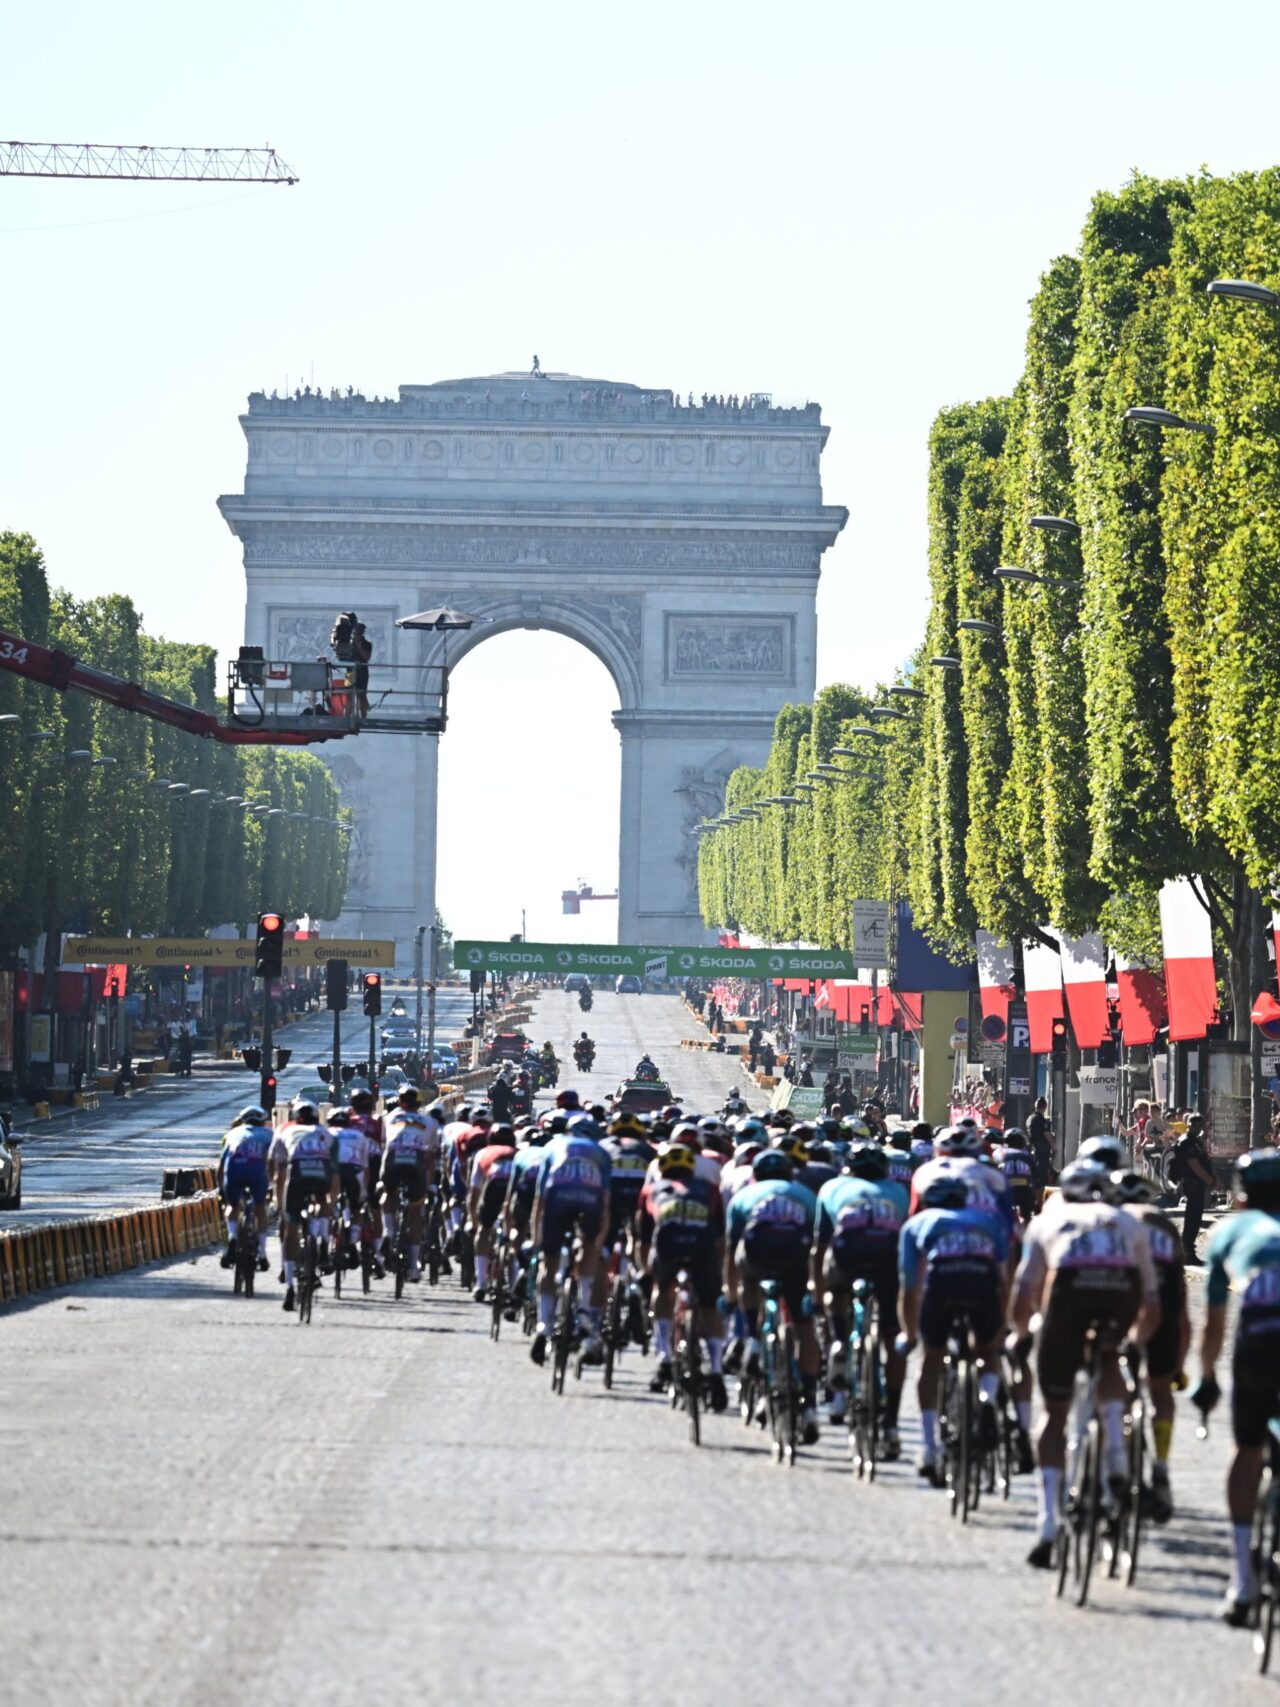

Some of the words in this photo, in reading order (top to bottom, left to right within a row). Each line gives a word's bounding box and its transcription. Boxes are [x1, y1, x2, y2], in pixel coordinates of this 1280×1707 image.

[0, 641, 28, 664] 34
[156, 945, 213, 958] Continental
[314, 946, 371, 960] Continental
[488, 950, 545, 964] ŠKODA
[577, 952, 634, 965] ŠKODA
[700, 955, 757, 968] ŠKODA
[788, 957, 846, 970] ŠKODA
[1013, 1026, 1029, 1047] P
